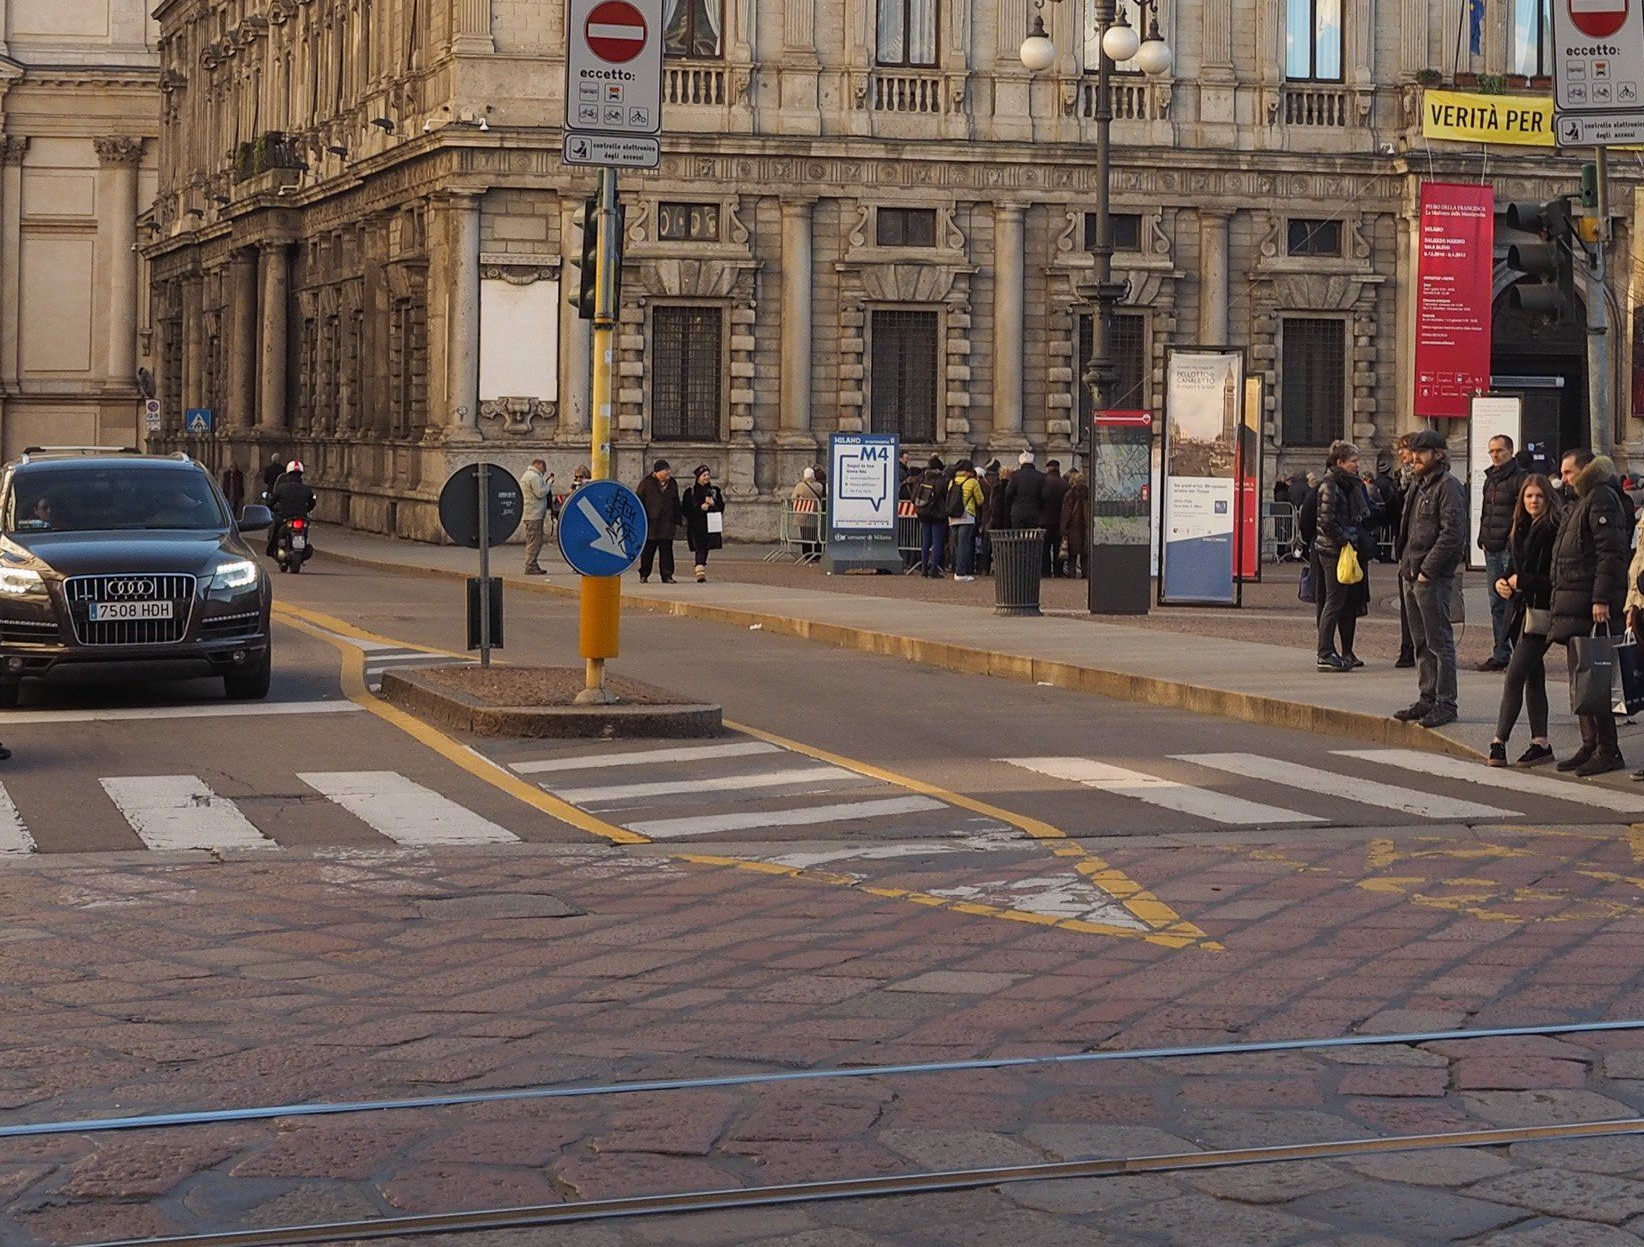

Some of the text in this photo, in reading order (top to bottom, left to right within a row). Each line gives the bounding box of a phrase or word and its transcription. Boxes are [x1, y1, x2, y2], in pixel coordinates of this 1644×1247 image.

[1566, 44, 1621, 56] eccetto:
[580, 69, 636, 81] eccetto:
[1431, 104, 1498, 130] VERITÀ
[1506, 110, 1542, 132] PER
[860, 446, 889, 461] M4
[100, 603, 169, 618] 7508 HDH
